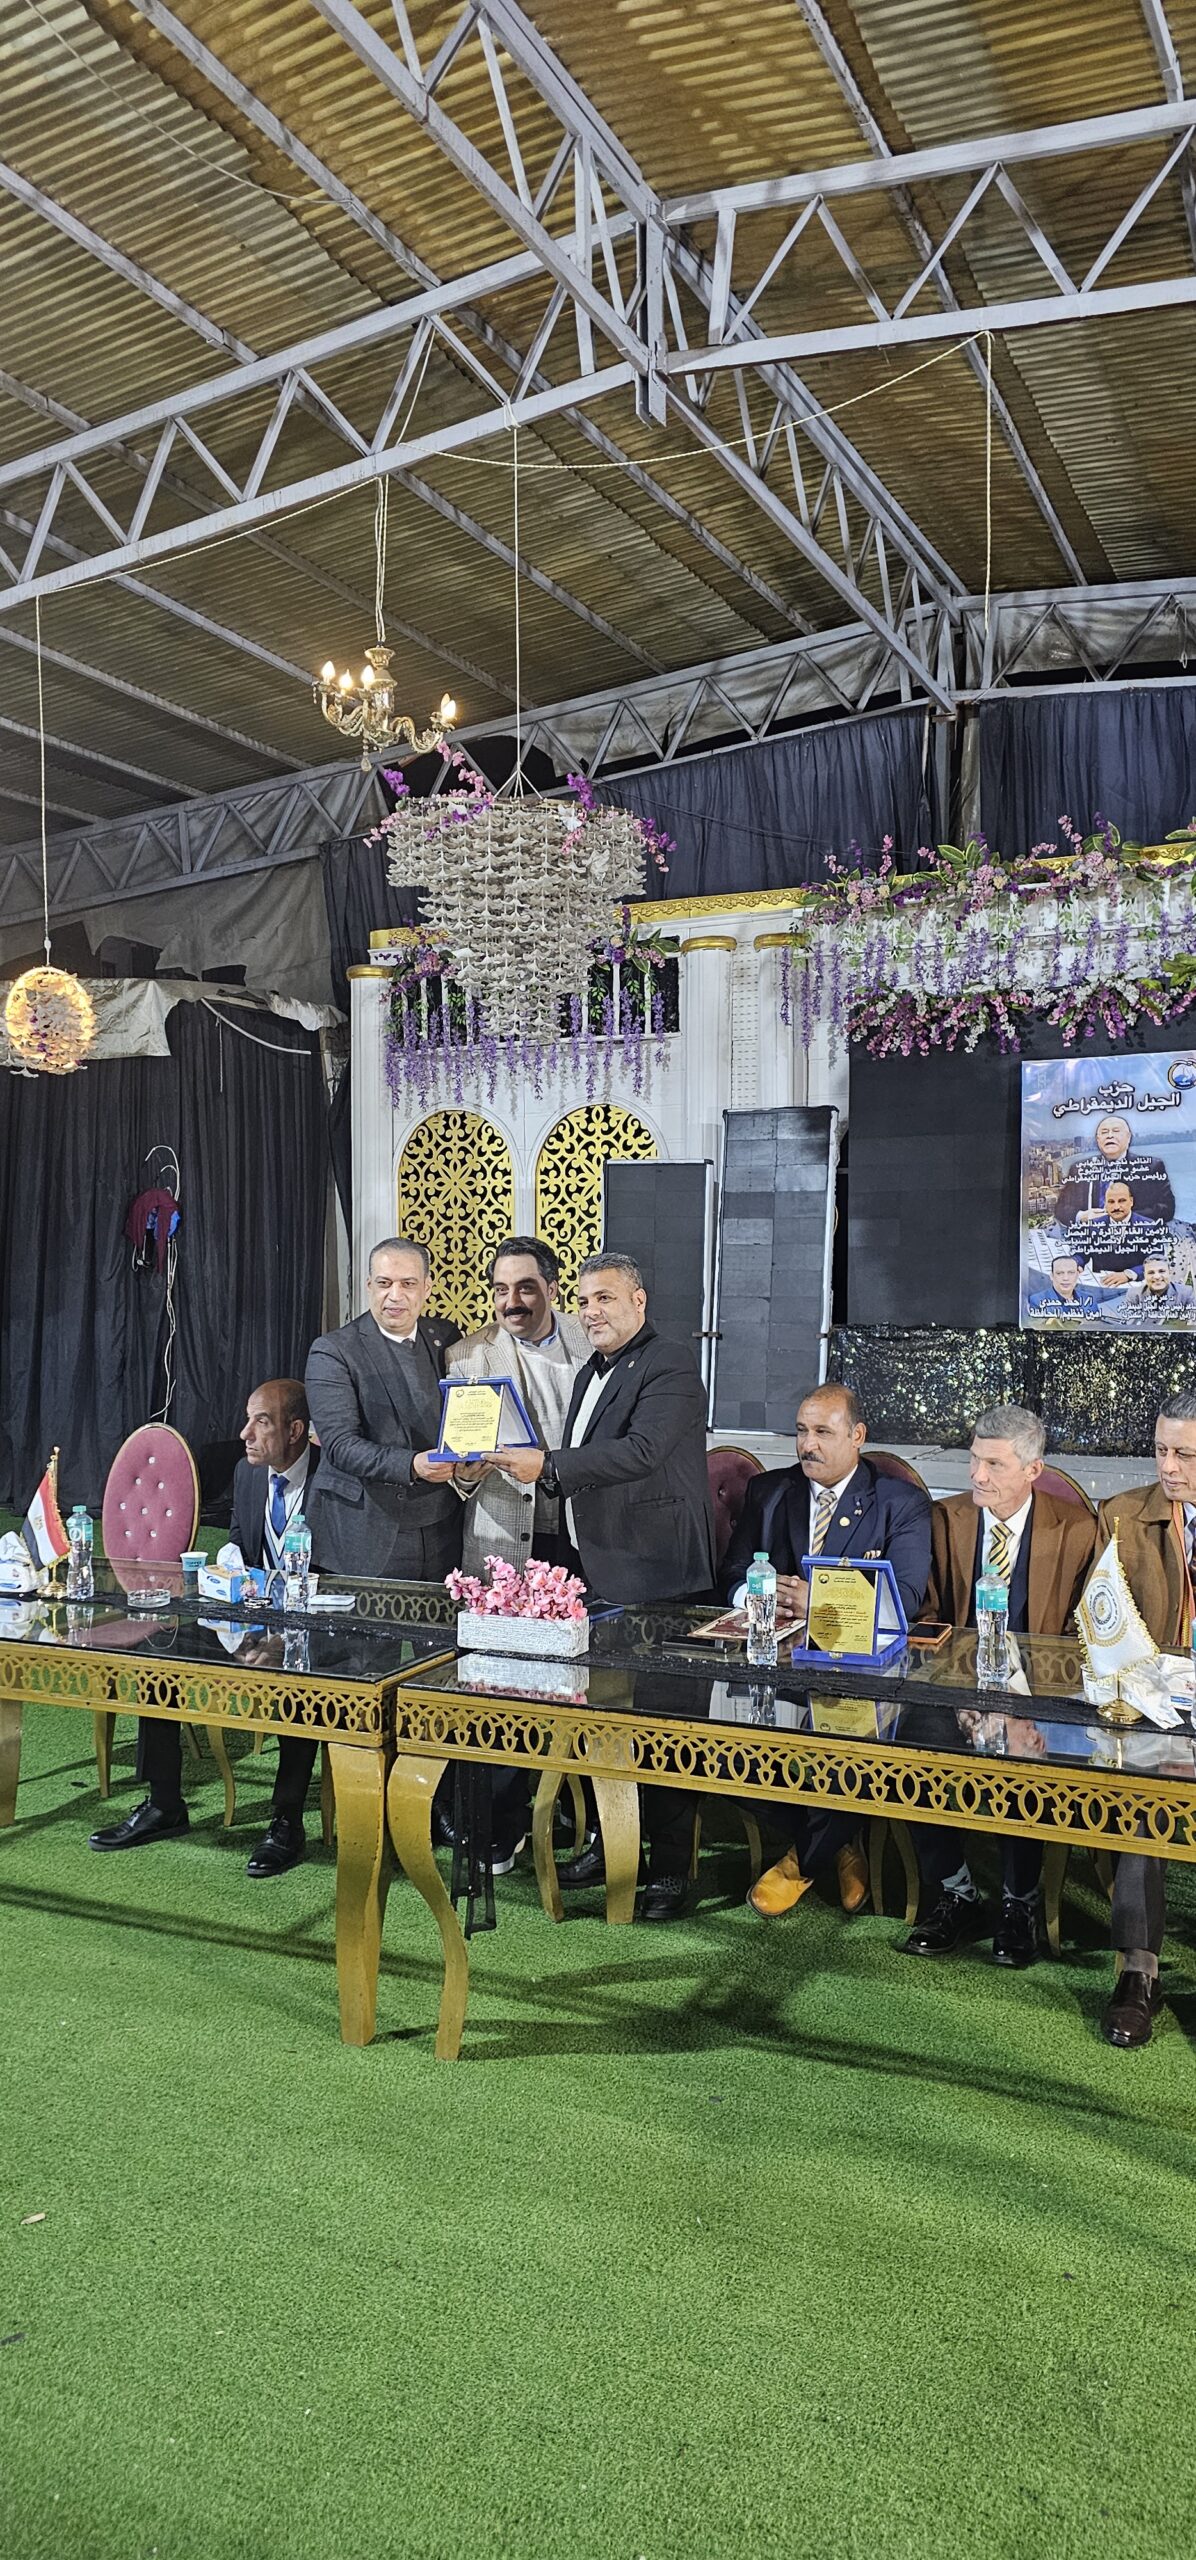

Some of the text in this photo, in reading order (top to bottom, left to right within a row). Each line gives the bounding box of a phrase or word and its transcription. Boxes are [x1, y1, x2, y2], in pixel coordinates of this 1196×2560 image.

[1098, 1081, 1135, 1097] حزب
[1053, 1091, 1182, 1117] الجيل الديمقراطي
[1123, 1173, 1140, 1182] حزب
[1115, 1244, 1138, 1255] الجيل
